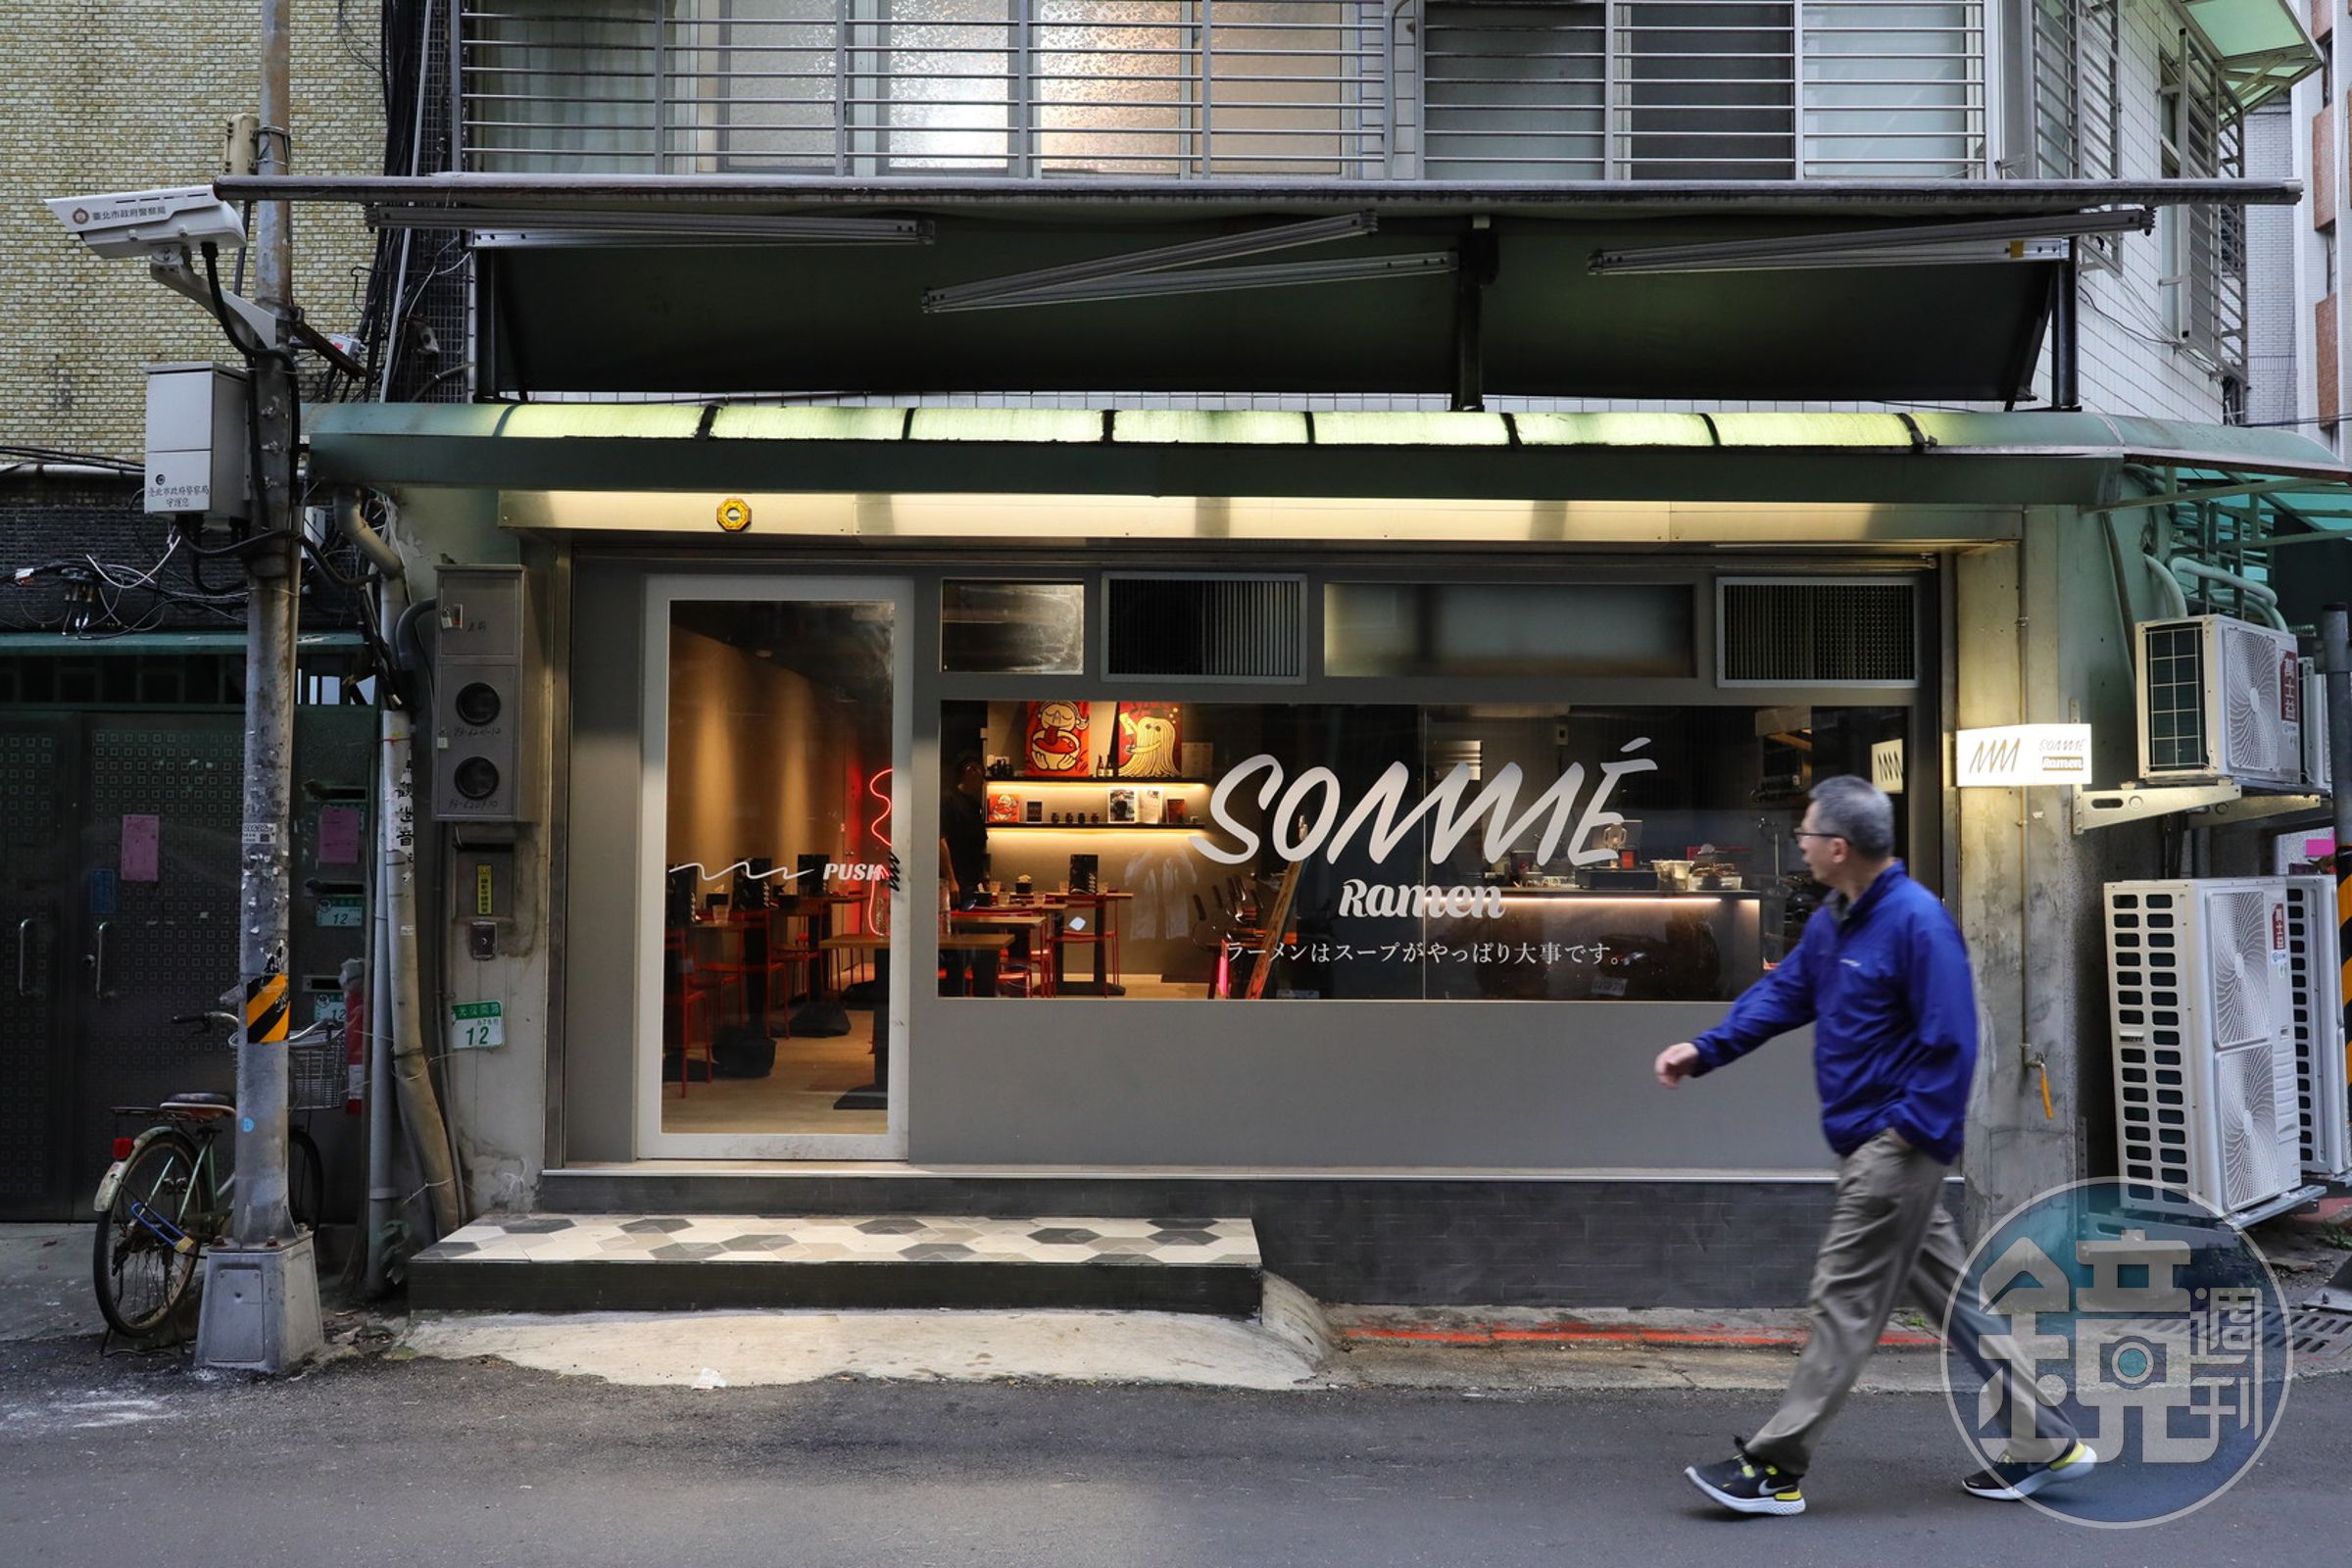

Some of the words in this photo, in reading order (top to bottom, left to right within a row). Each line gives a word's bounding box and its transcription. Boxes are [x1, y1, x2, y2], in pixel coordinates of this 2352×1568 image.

[92, 206, 166, 220] 臺北市政府警察局
[1189, 737, 1658, 866] SOMMÉ
[822, 862, 887, 882] PUSH
[1338, 878, 1506, 919] Ramen
[1225, 941, 1622, 965] ラーメンはスープがやっぱり大事です。
[466, 1026, 489, 1046] 12
